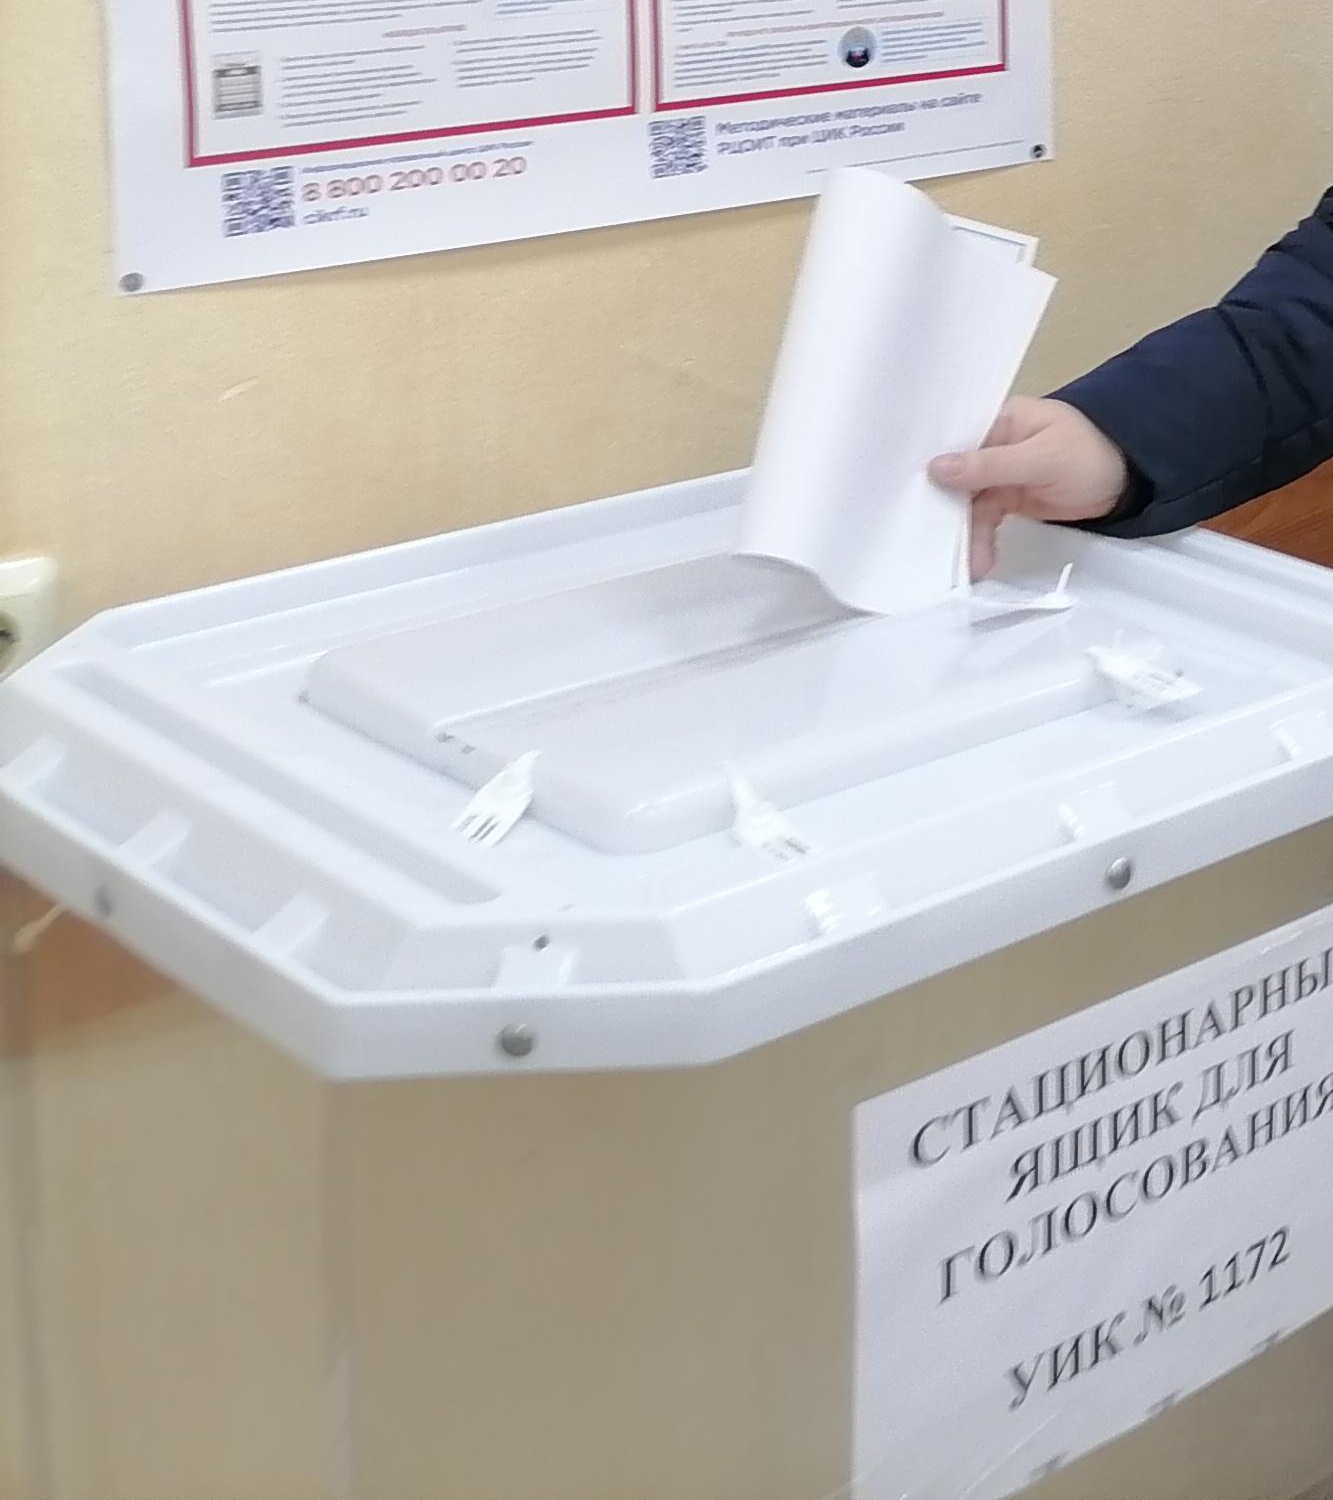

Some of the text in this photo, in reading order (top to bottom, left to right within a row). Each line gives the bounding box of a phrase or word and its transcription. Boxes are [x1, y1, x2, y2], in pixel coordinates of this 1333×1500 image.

[300, 181, 322, 202] 8
[326, 174, 384, 199] 800
[388, 166, 444, 192] 200
[449, 160, 488, 182] 00
[492, 155, 528, 178] 20
[1004, 1027, 1298, 1204] ЯЩИК ДЛЯ
[1004, 1225, 1292, 1412] УИК № 1172
